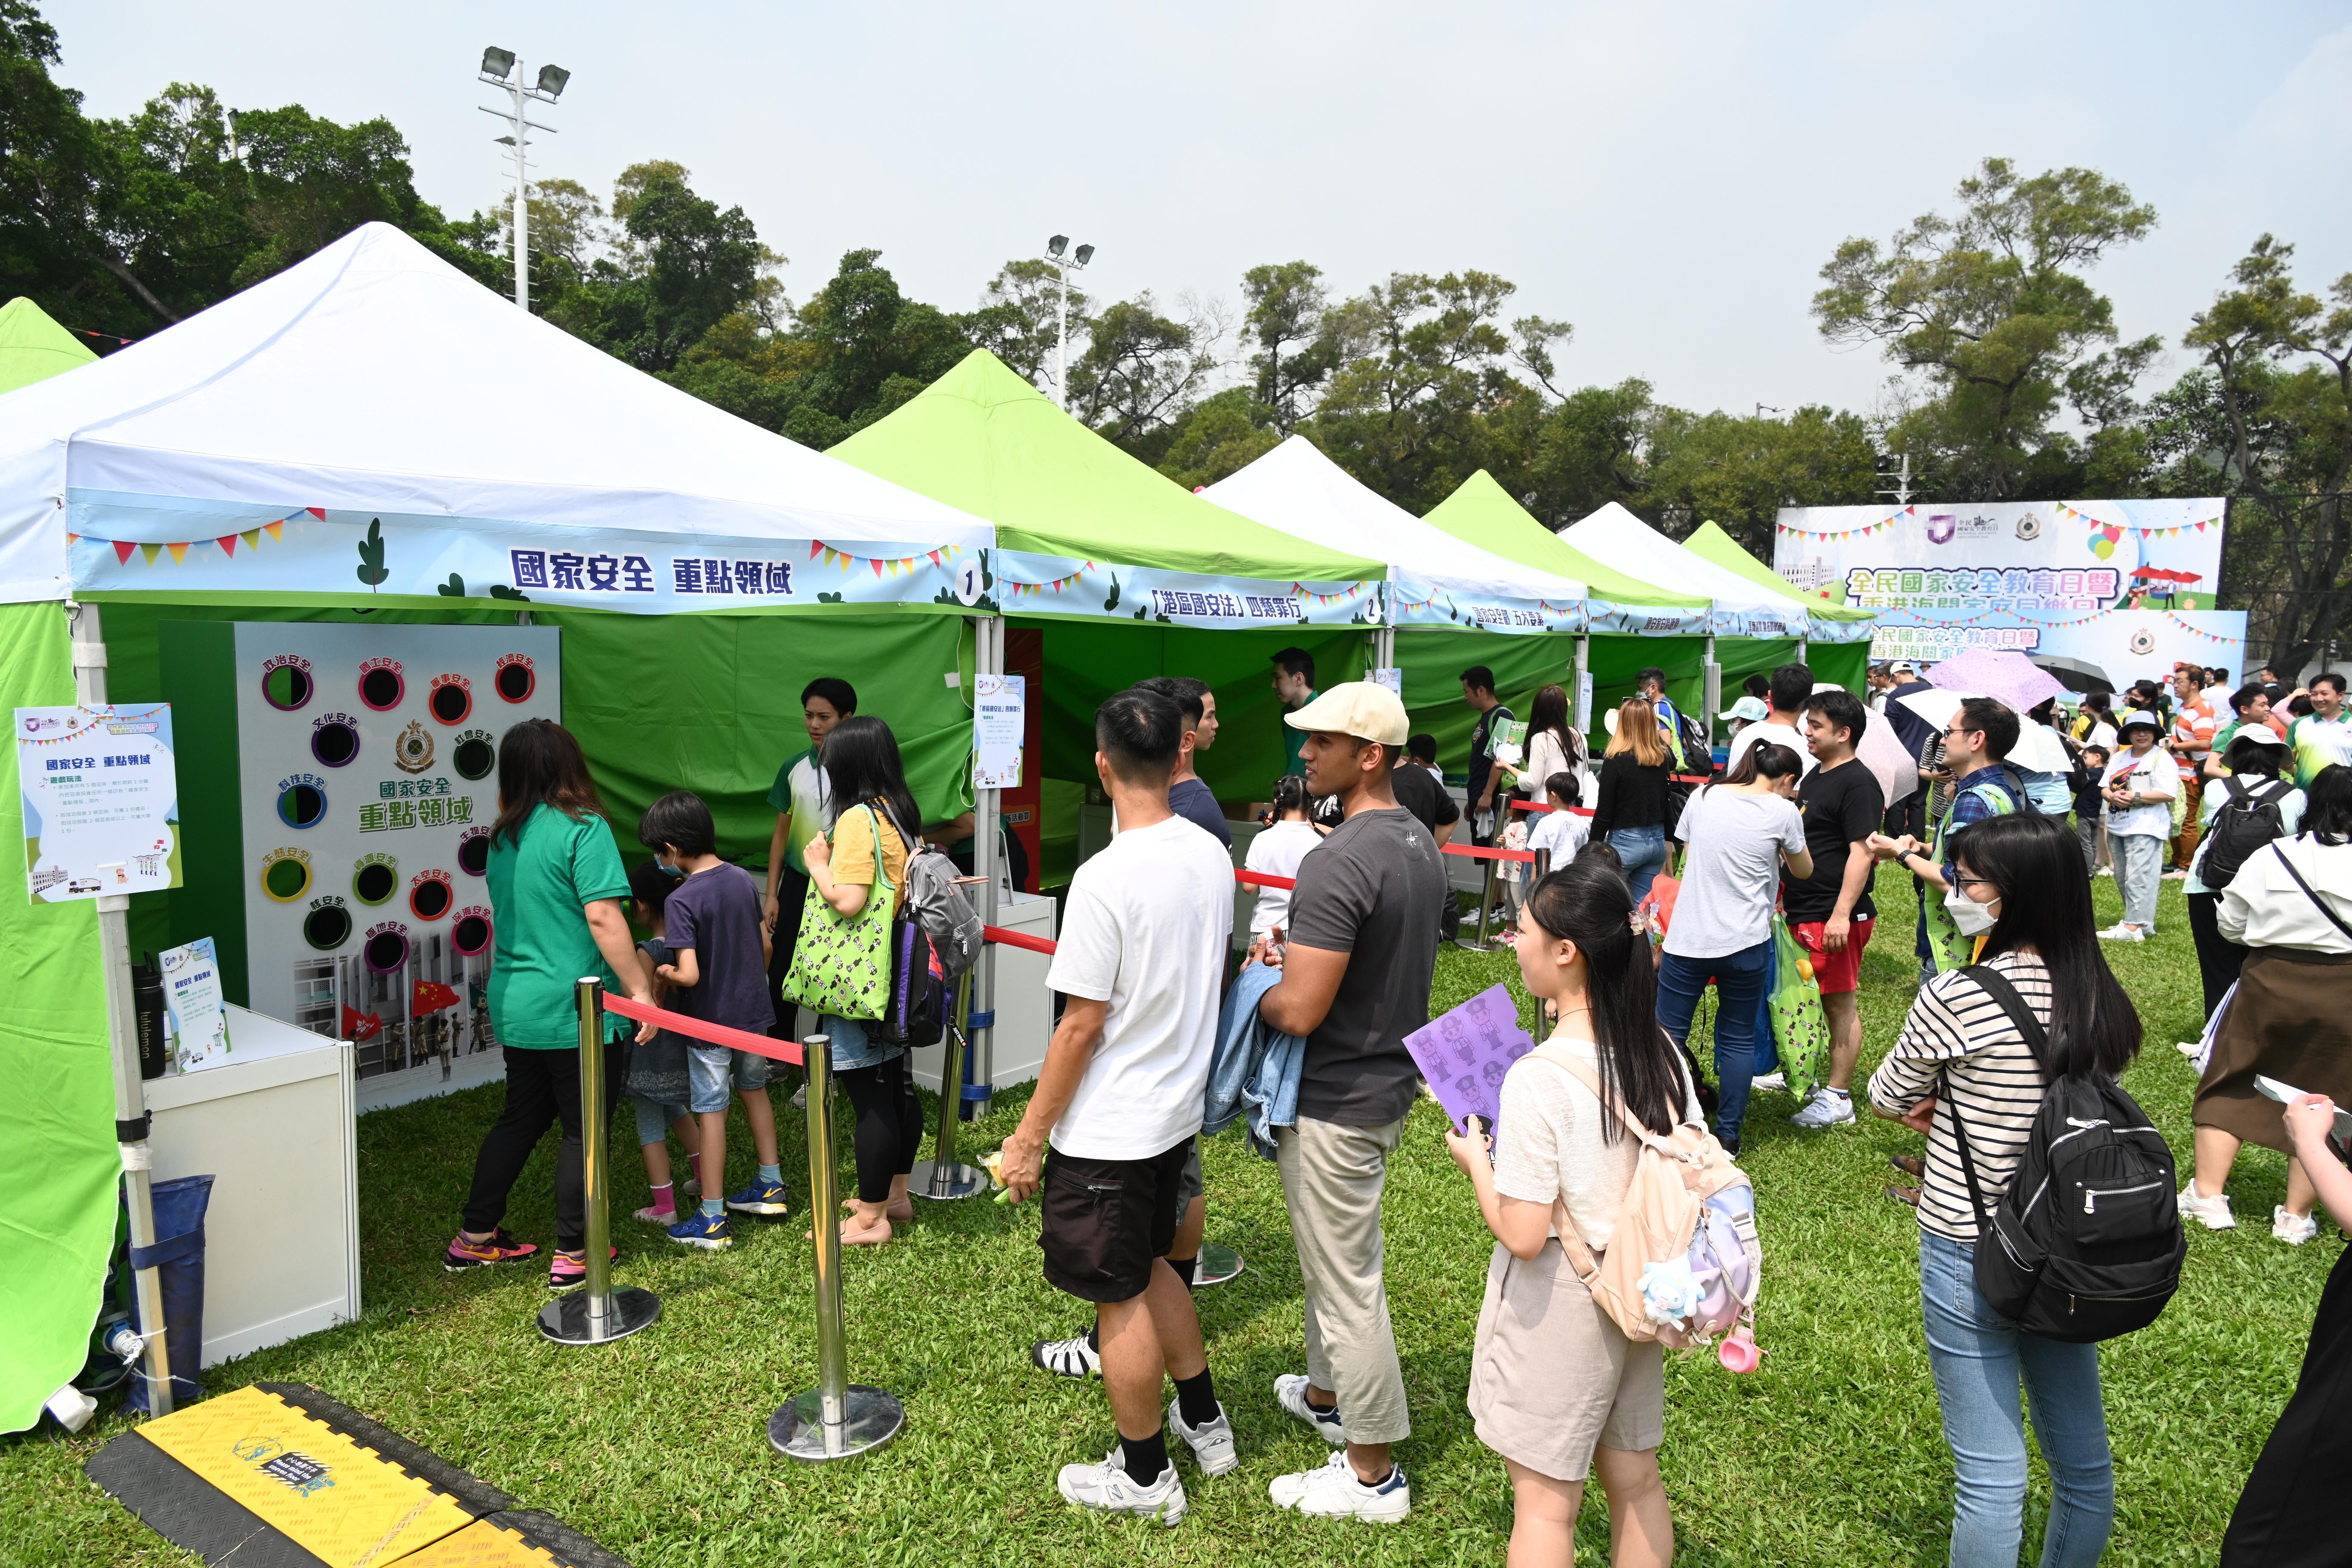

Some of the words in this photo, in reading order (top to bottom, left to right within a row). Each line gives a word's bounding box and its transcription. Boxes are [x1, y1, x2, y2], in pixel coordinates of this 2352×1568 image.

[511, 549, 654, 592] 國家安全
[673, 559, 793, 594] 重點領域
[965, 570, 973, 595] 1
[1852, 573, 2113, 594] 全民國家安全教育日暨
[1368, 600, 1375, 617] 2
[1472, 606, 1511, 626] 國家安全觀
[1514, 610, 1544, 627] 五大要素
[263, 654, 312, 673] 政治安全
[359, 657, 403, 674] 國土安全
[496, 653, 534, 669] 經濟安全
[430, 673, 471, 690] 軍事安全
[312, 712, 358, 730] 文化安全
[454, 729, 494, 746] 社會安全
[46, 757, 96, 771] 國家安全
[103, 754, 151, 767] 重點領域
[50, 775, 82, 784] 遊戲玩法
[278, 773, 326, 792] 科技安全
[379, 777, 451, 798] 國家安全
[359, 796, 472, 832] 重點領域
[460, 826, 491, 843] 生物安
[262, 847, 310, 867] 生態安全
[353, 853, 397, 872] 資源安全
[411, 868, 452, 888] 太空安全
[309, 895, 345, 911] 核安全
[452, 906, 491, 924] 深海安全
[365, 921, 408, 939] 極地安全
[175, 977, 192, 989] 國家安全
[194, 971, 211, 982] 重點領域
[140, 1011, 151, 1059] lululemon
[268, 1464, 287, 1476] uneven
[286, 1472, 300, 1481] floor
[273, 1459, 290, 1468] Please
[288, 1465, 303, 1475] mind
[301, 1471, 312, 1480] the
[285, 1456, 318, 1473] 小心地面不平
